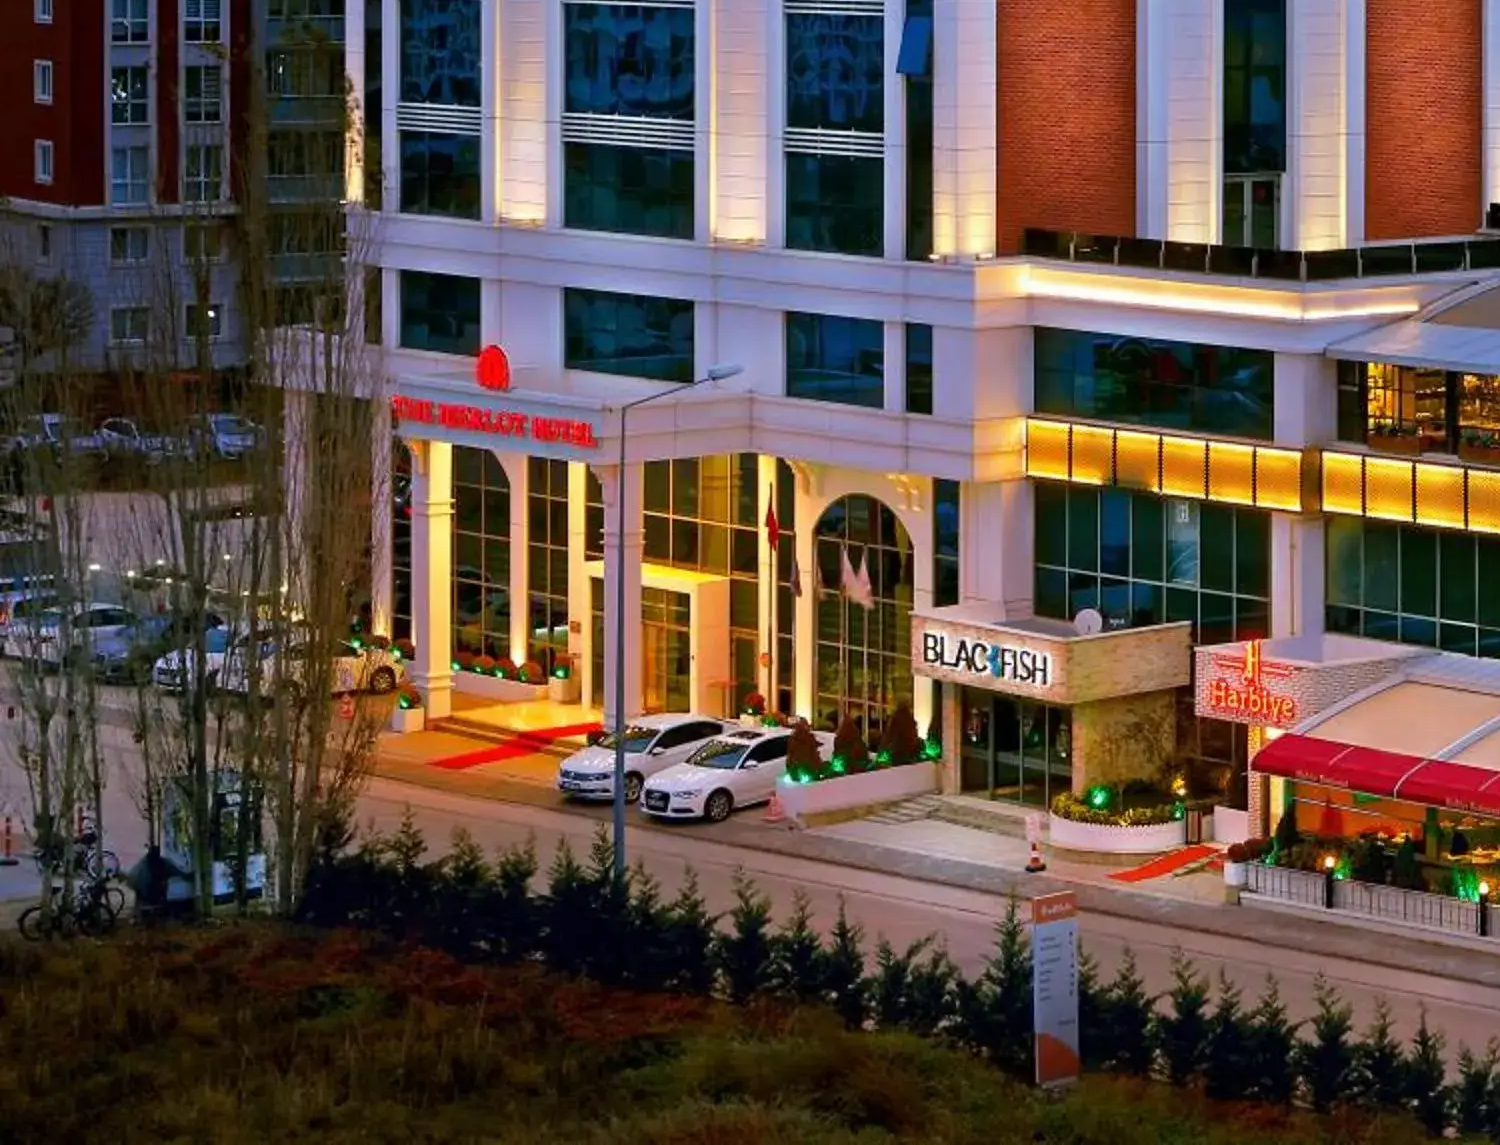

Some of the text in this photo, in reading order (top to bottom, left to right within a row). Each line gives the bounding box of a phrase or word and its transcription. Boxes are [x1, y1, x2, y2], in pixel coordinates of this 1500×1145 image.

[391, 393, 600, 448] THE MERLOT HOTEL
[1209, 680, 1295, 720] Harbiye
